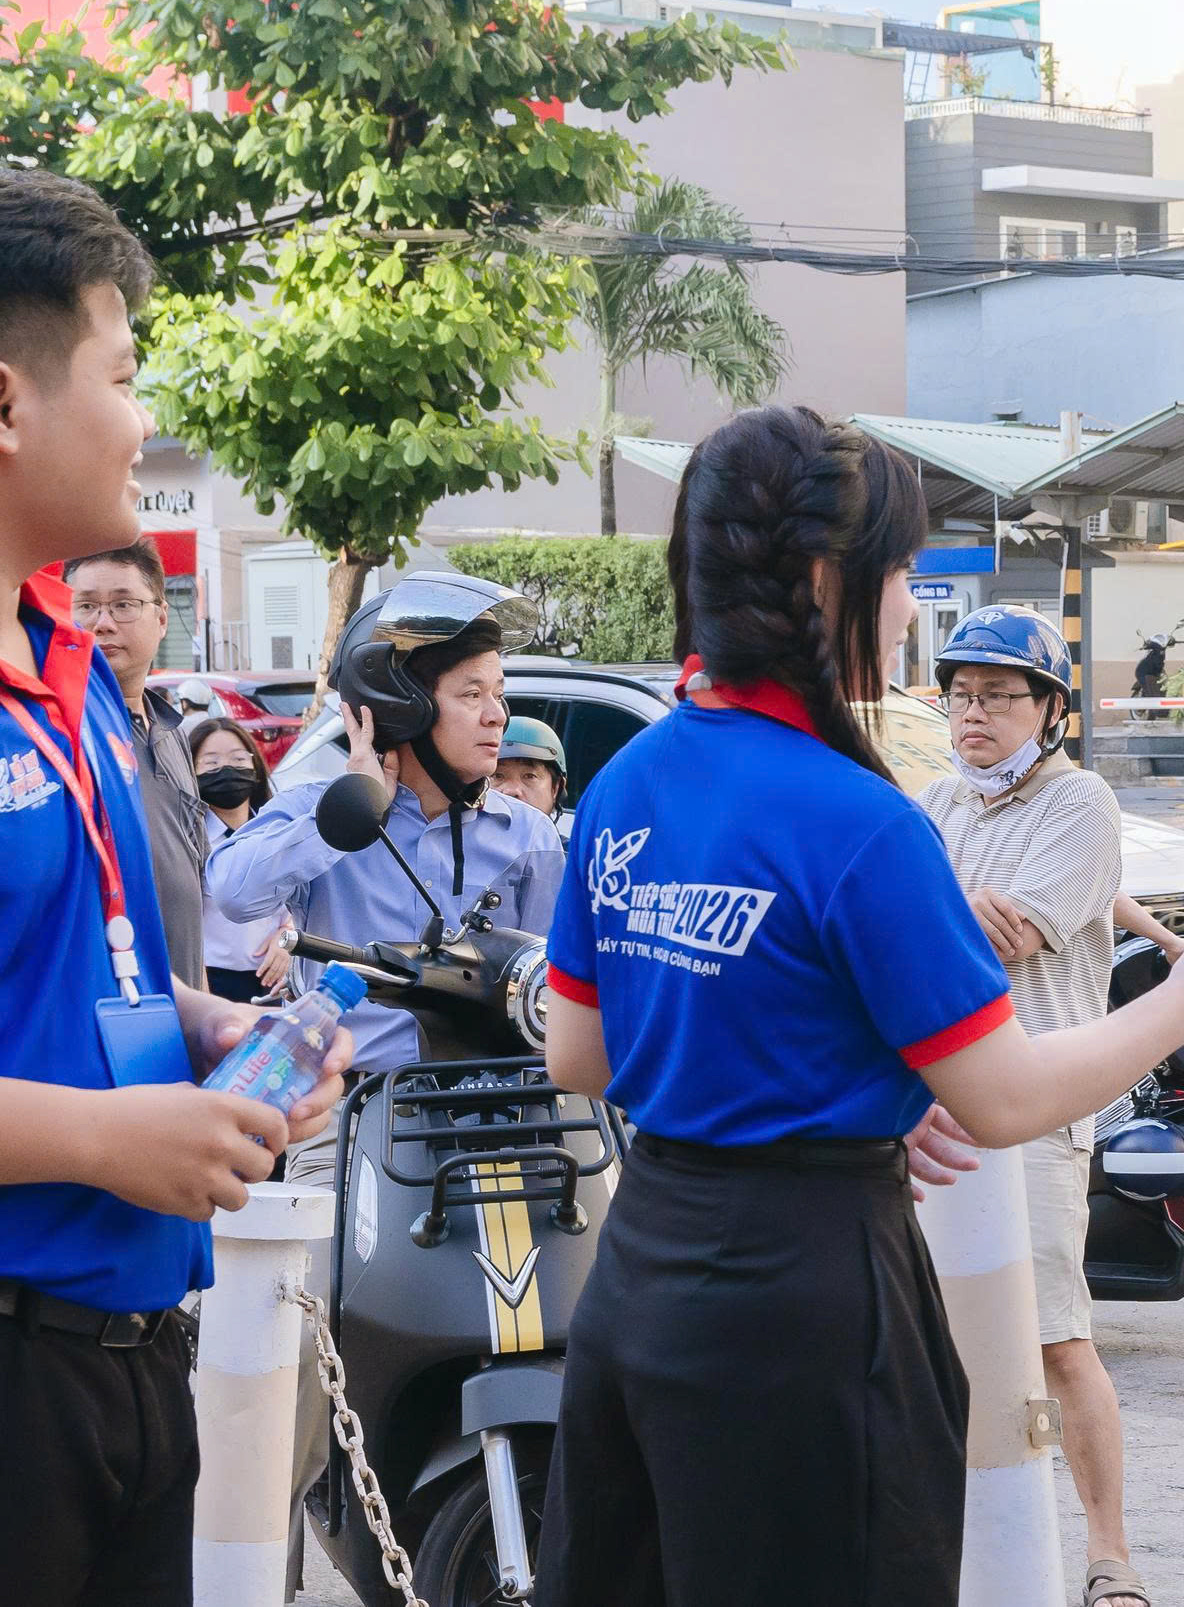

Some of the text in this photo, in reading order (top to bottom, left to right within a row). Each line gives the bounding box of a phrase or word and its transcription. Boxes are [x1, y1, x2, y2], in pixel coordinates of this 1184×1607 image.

[936, 587, 948, 597] RA
[630, 881, 681, 910] TIẾP SỨC
[626, 908, 657, 935] MÙA
[673, 888, 758, 948] 2026
[596, 936, 618, 953] HÃY
[620, 940, 635, 957] TỰ
[692, 959, 722, 977] BẠN
[236, 1051, 273, 1085] Life
